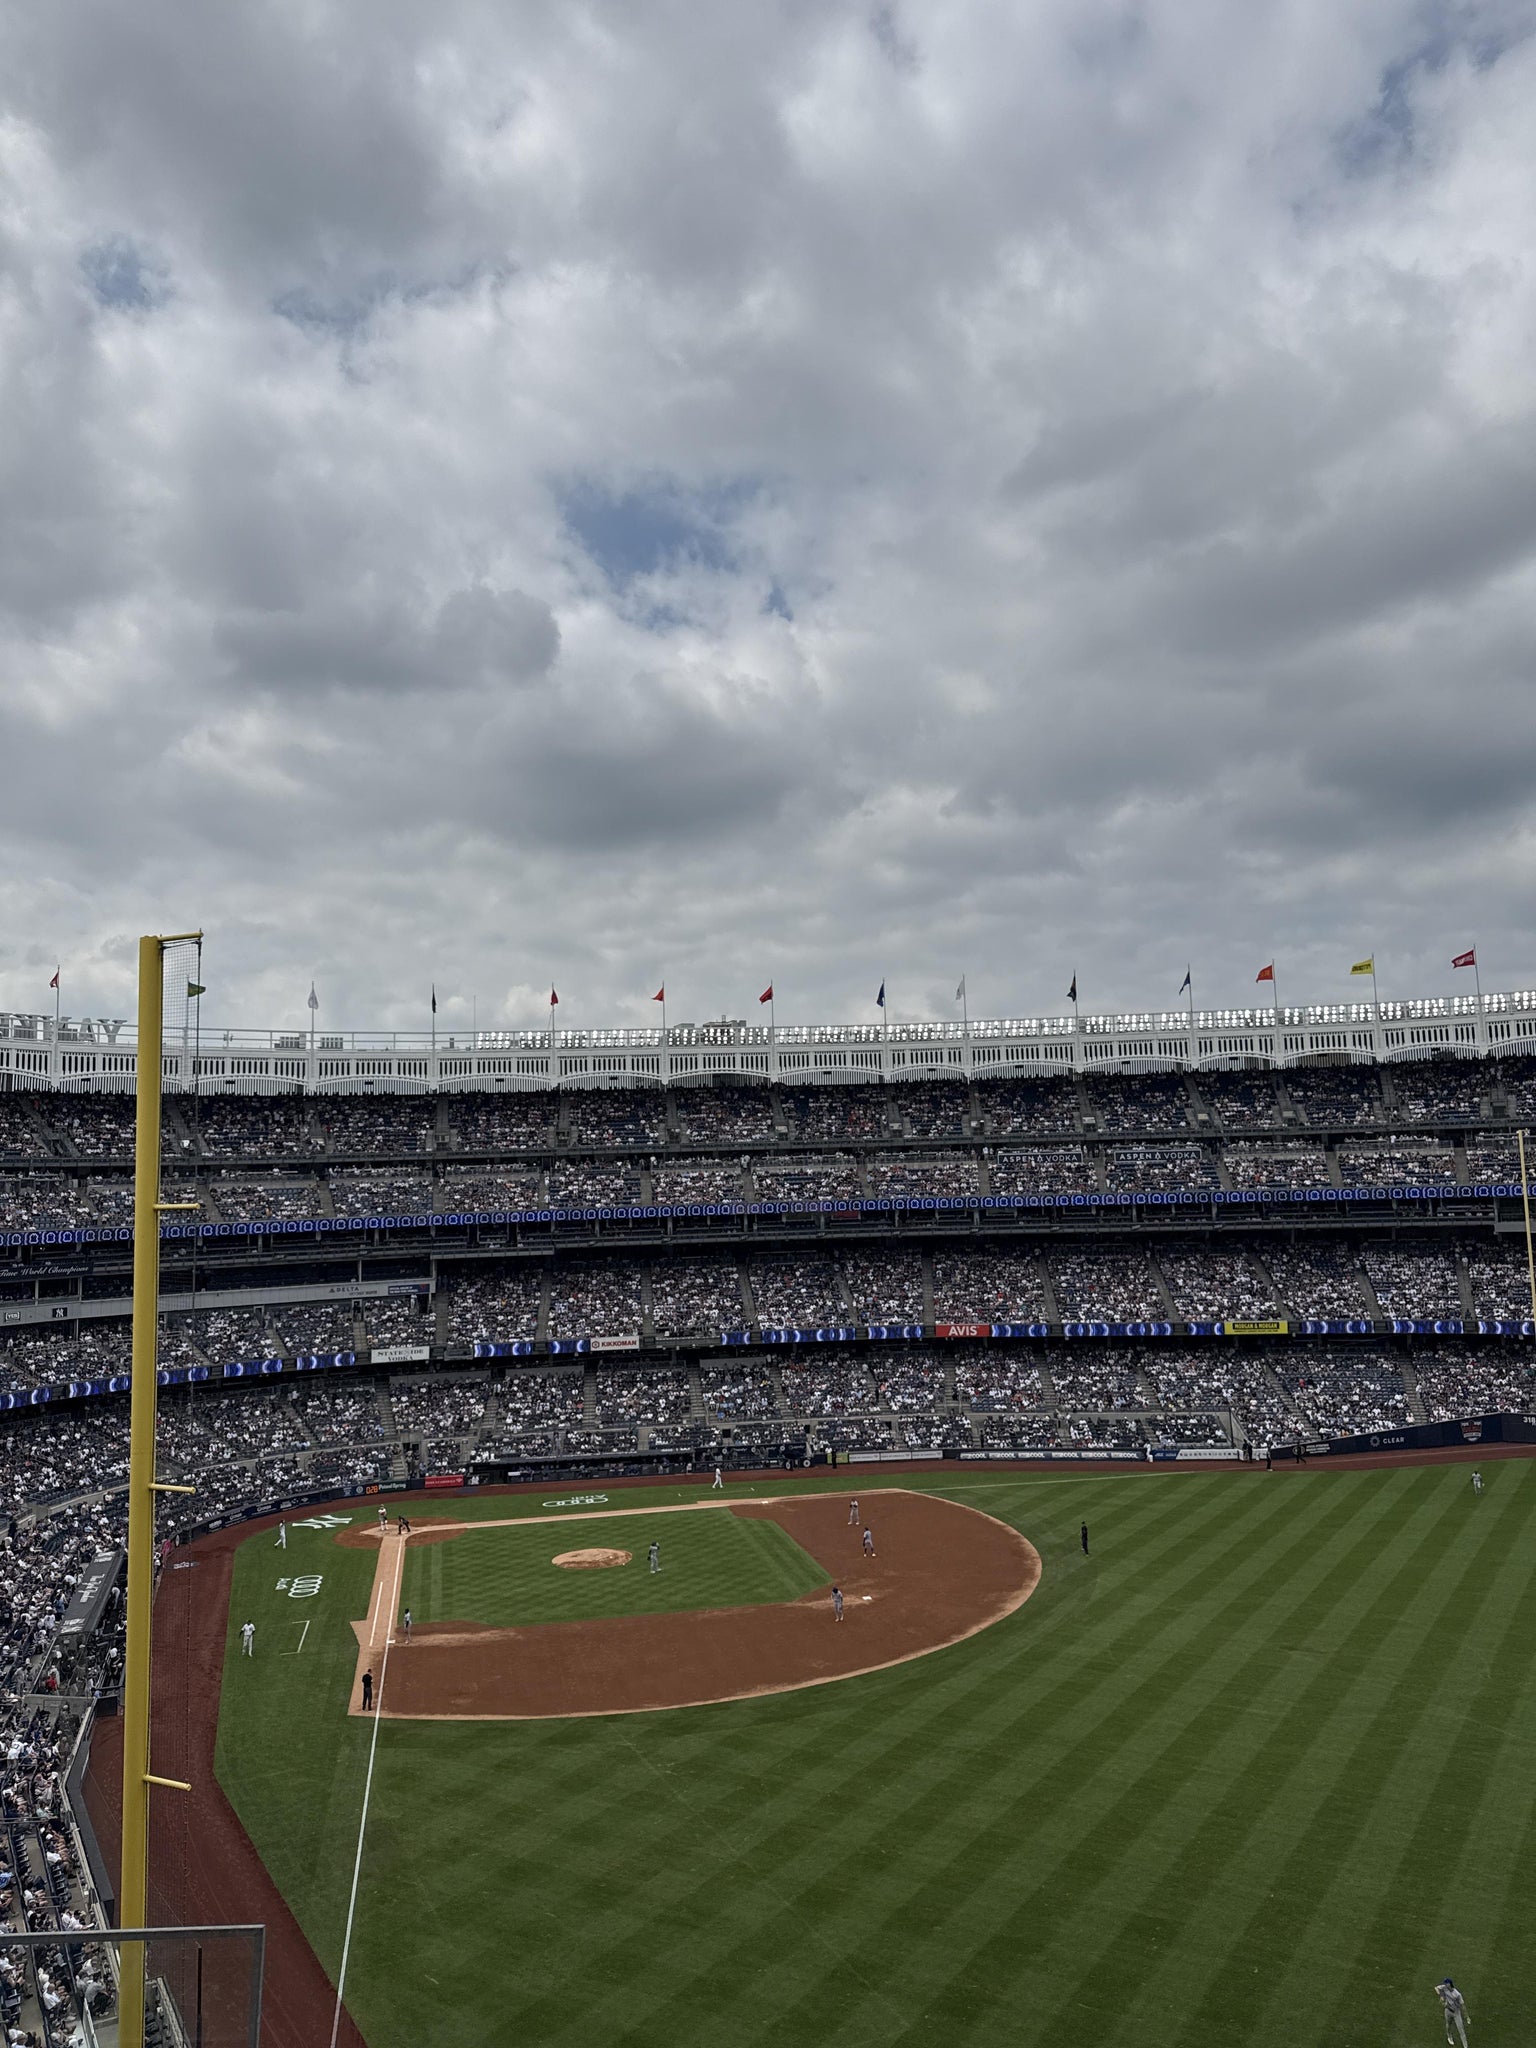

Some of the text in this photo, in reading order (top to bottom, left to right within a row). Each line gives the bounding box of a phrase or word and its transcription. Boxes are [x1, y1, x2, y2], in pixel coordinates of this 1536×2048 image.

[1003, 1154, 1078, 1163] ASPEN VODKA
[21, 1267, 45, 1276] World
[48, 1266, 88, 1276] Champions
[949, 1326, 978, 1336] AVIS
[1383, 1436, 1405, 1444] CLEAR
